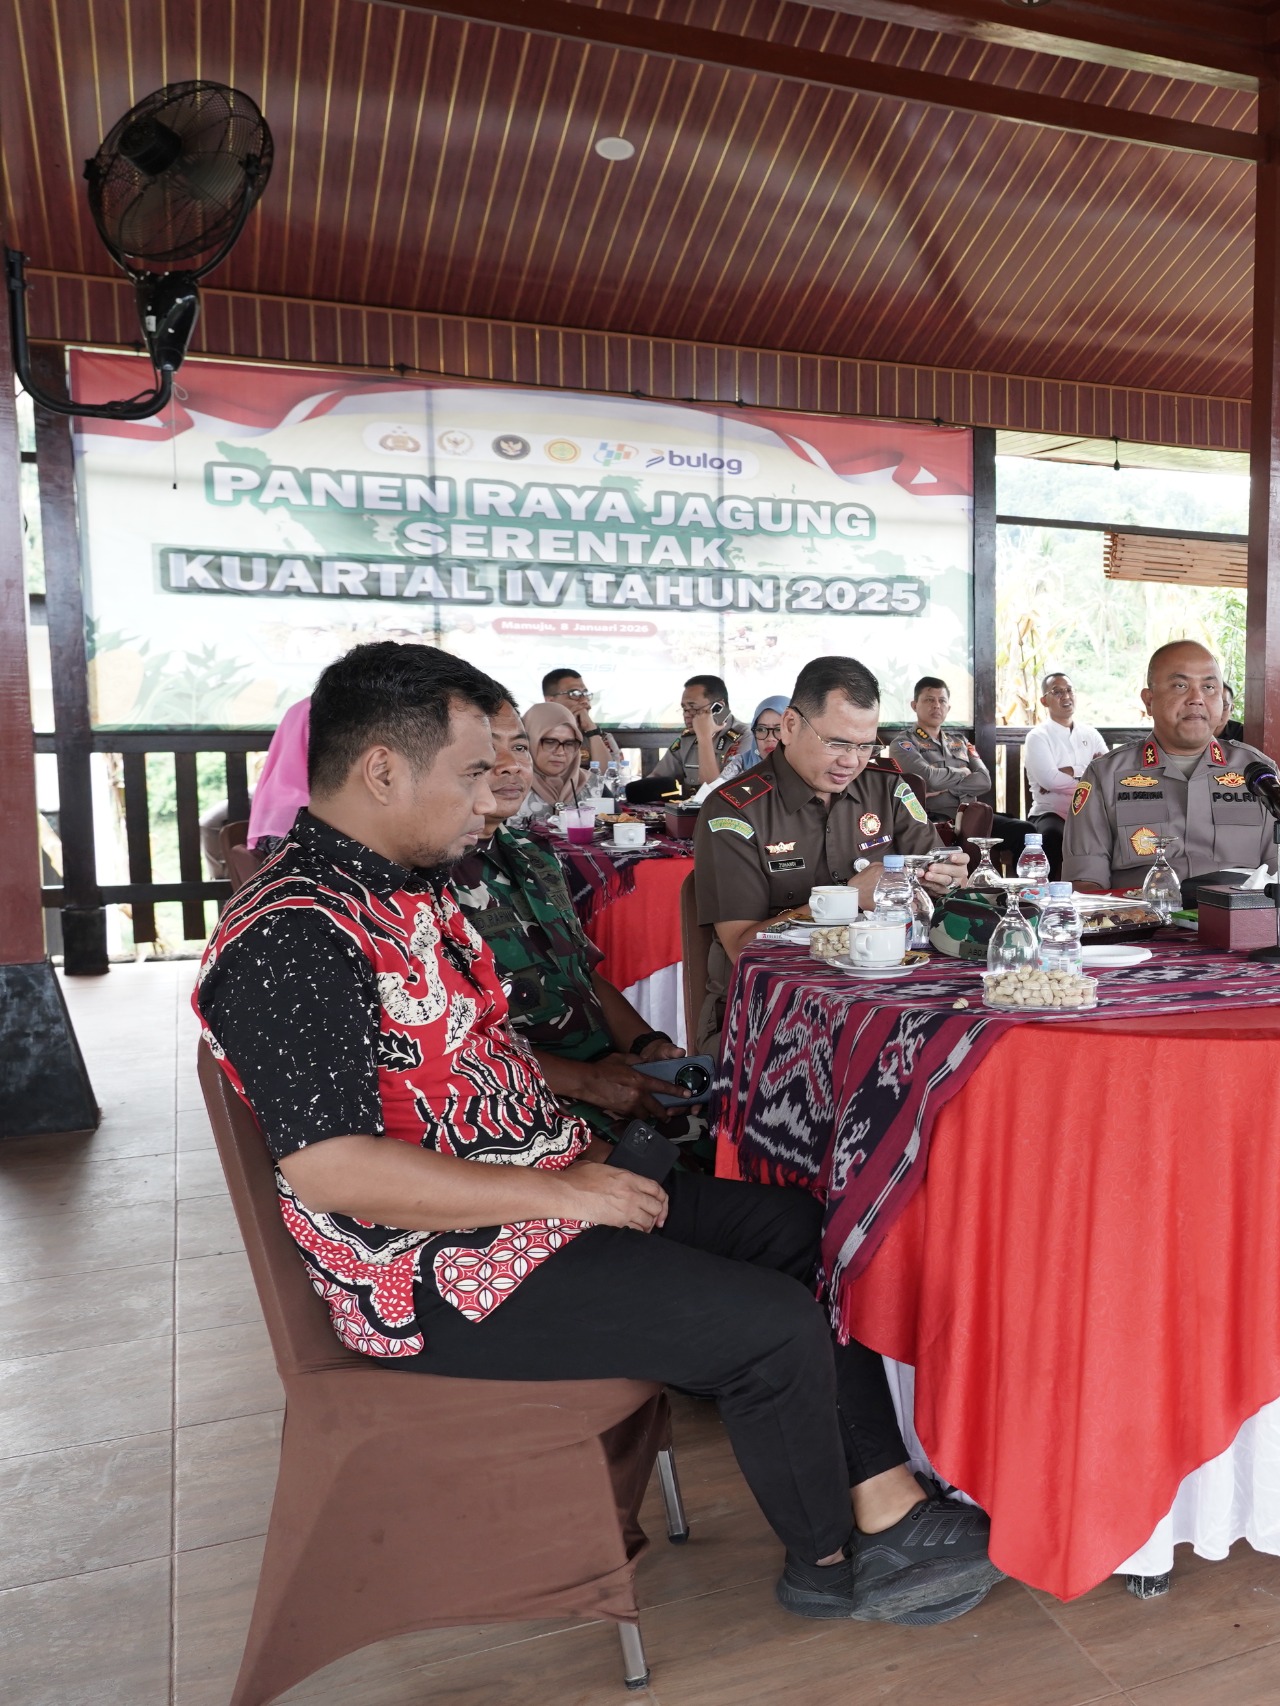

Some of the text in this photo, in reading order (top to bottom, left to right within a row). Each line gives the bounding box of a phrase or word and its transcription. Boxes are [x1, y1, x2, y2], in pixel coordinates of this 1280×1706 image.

[668, 450, 742, 475] bulog
[212, 466, 871, 537] PANEN RAYA JAGUNG
[402, 521, 730, 568] SERENTAK
[168, 553, 921, 612] KUARTAL IV TAHUN 2025
[501, 620, 649, 633] Mamuju, 8 Januari 2026
[1212, 791, 1257, 803] POLRI
